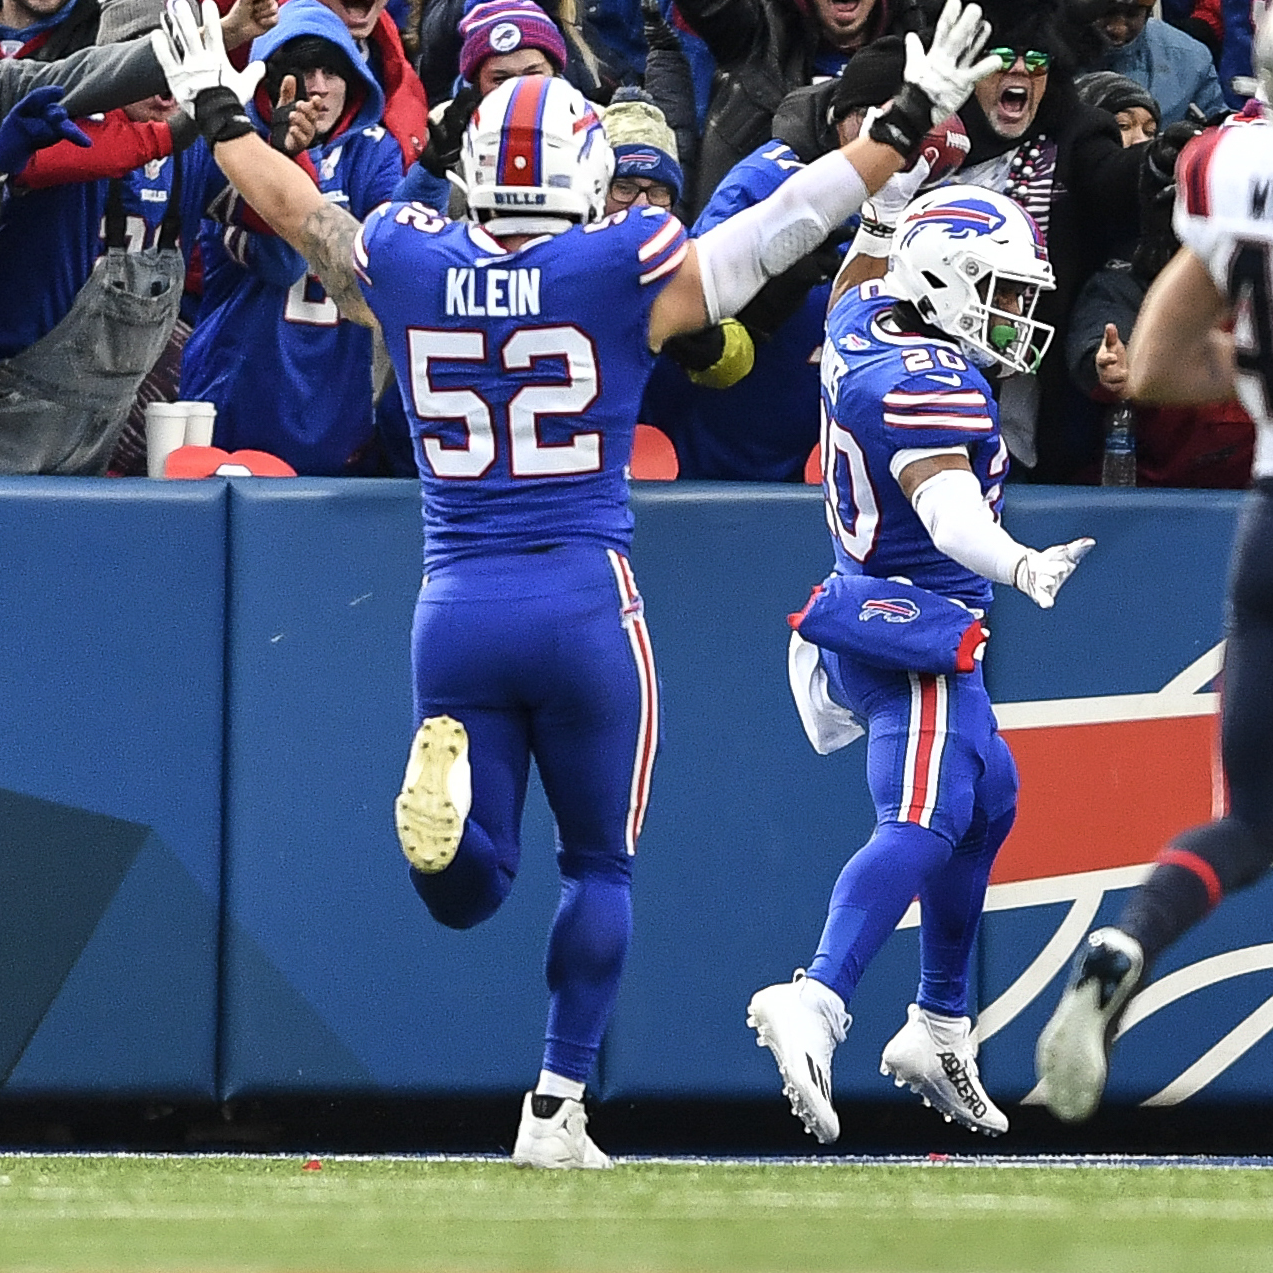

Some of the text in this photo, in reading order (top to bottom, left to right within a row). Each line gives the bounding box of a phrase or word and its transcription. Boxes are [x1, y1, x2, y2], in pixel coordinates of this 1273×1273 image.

[494, 192, 546, 206] BILLS
[445, 267, 542, 317] KLEIN
[900, 348, 968, 373] 20
[407, 325, 602, 478] 52
[821, 416, 880, 565] 0
[935, 1051, 987, 1121] ADIZERO
